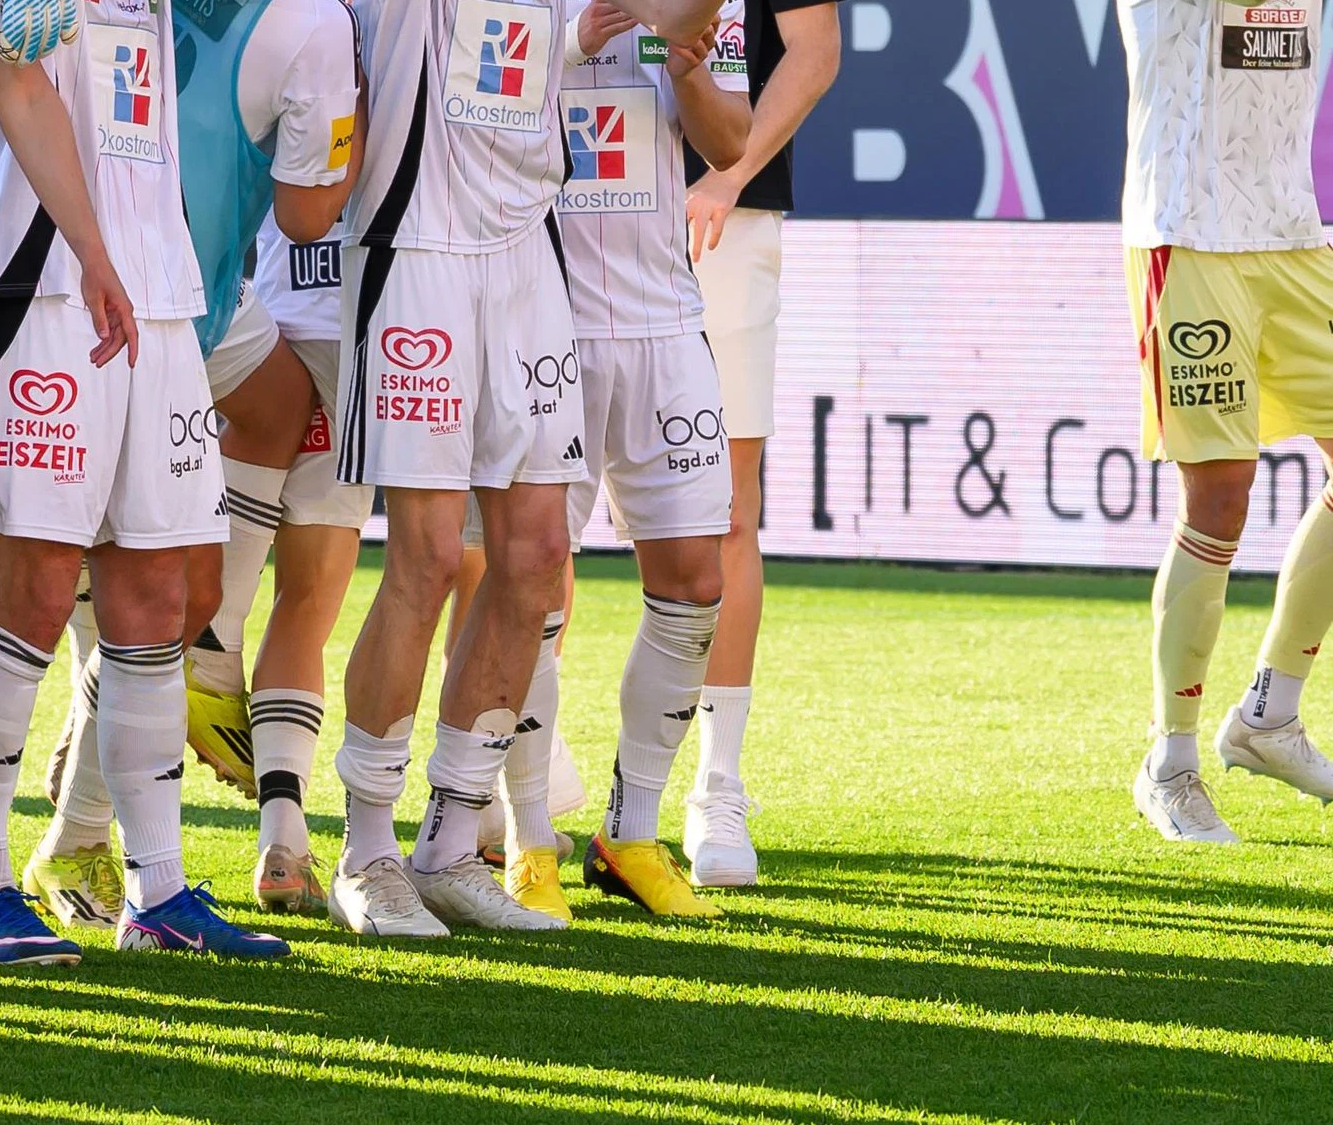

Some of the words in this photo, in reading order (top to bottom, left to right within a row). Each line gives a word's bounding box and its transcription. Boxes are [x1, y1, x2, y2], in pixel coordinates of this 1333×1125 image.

[1242, 58, 1258, 67] Der
[445, 92, 539, 127] Ökostrom
[380, 373, 452, 393] ESKIMO
[1171, 362, 1234, 381] ESKIMO
[1169, 379, 1246, 407] EISZEIT
[376, 395, 463, 423] EISZEIT
[6, 418, 76, 441] ESKIMO
[170, 454, 203, 478] bgd.at
[668, 452, 721, 475] bgd.at
[953, 411, 1012, 520] &
